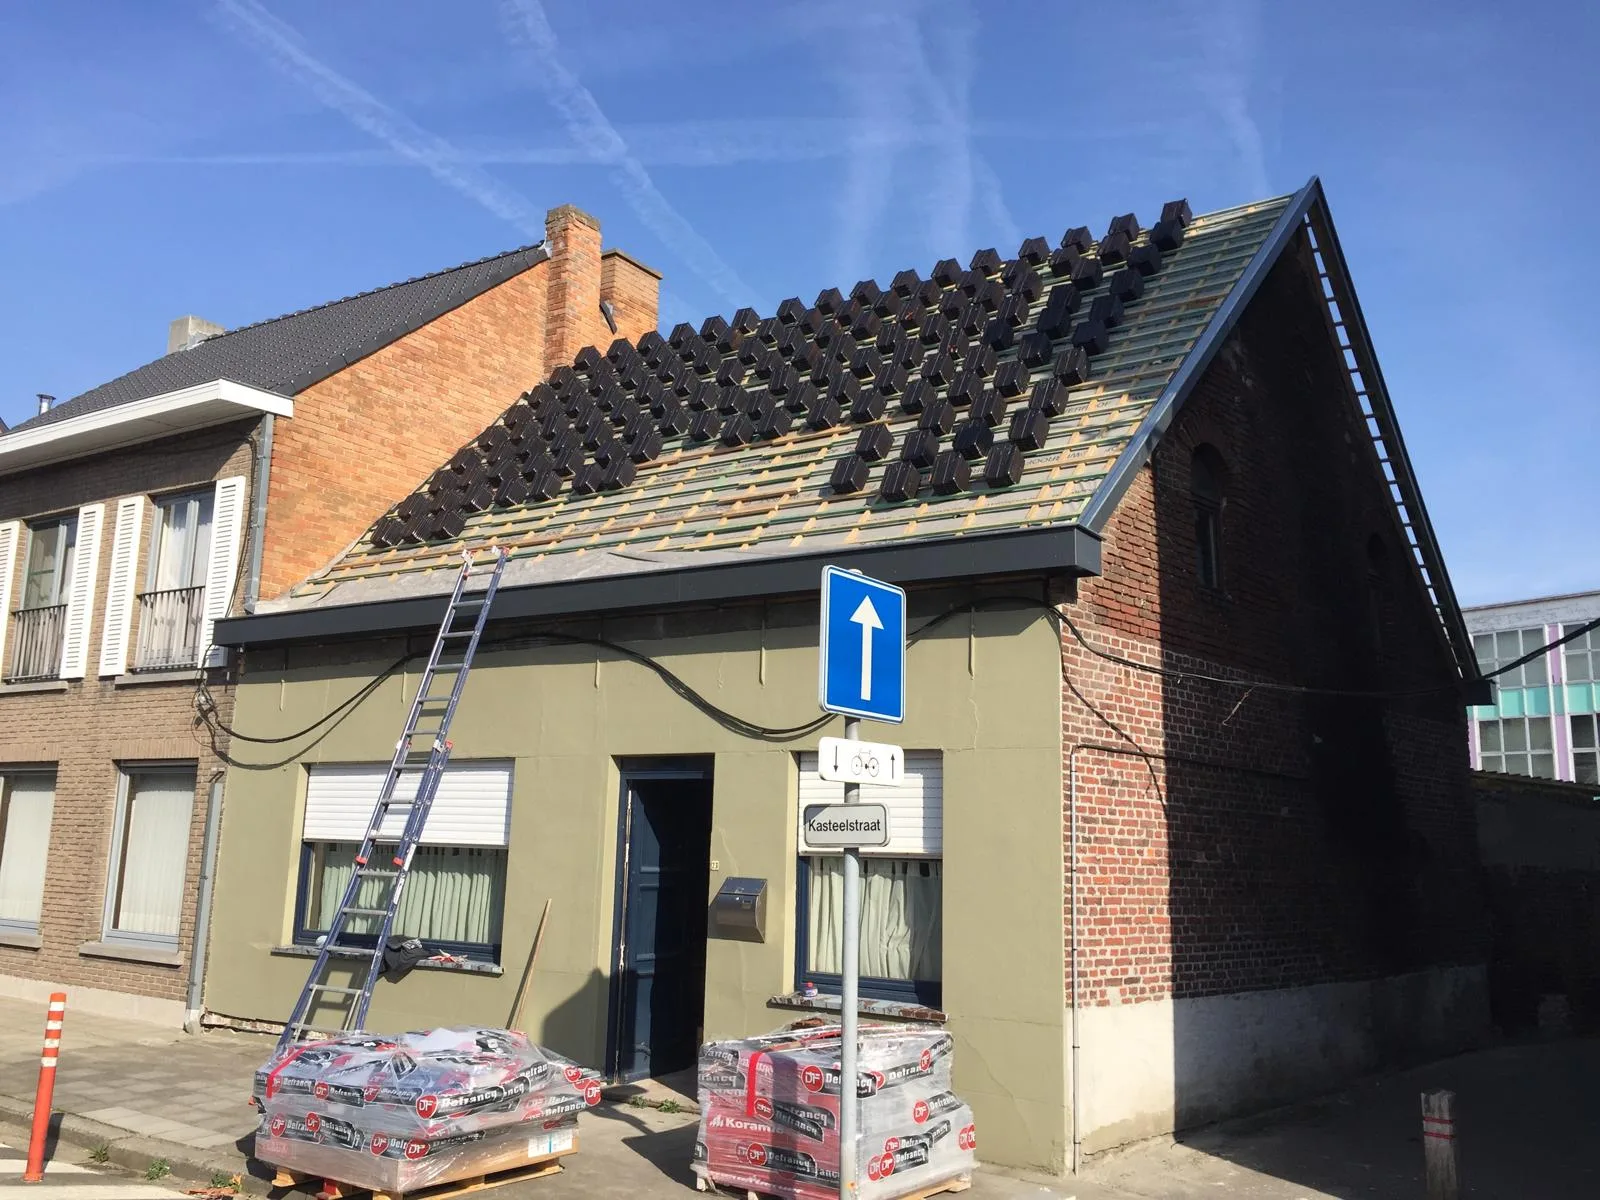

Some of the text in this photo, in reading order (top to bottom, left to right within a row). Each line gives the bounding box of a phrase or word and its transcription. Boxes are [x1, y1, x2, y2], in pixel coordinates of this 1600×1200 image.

[808, 819, 881, 832] Kasteelstraat
[805, 1072, 821, 1084] DF
[419, 1090, 498, 1111] DF Defrancq
